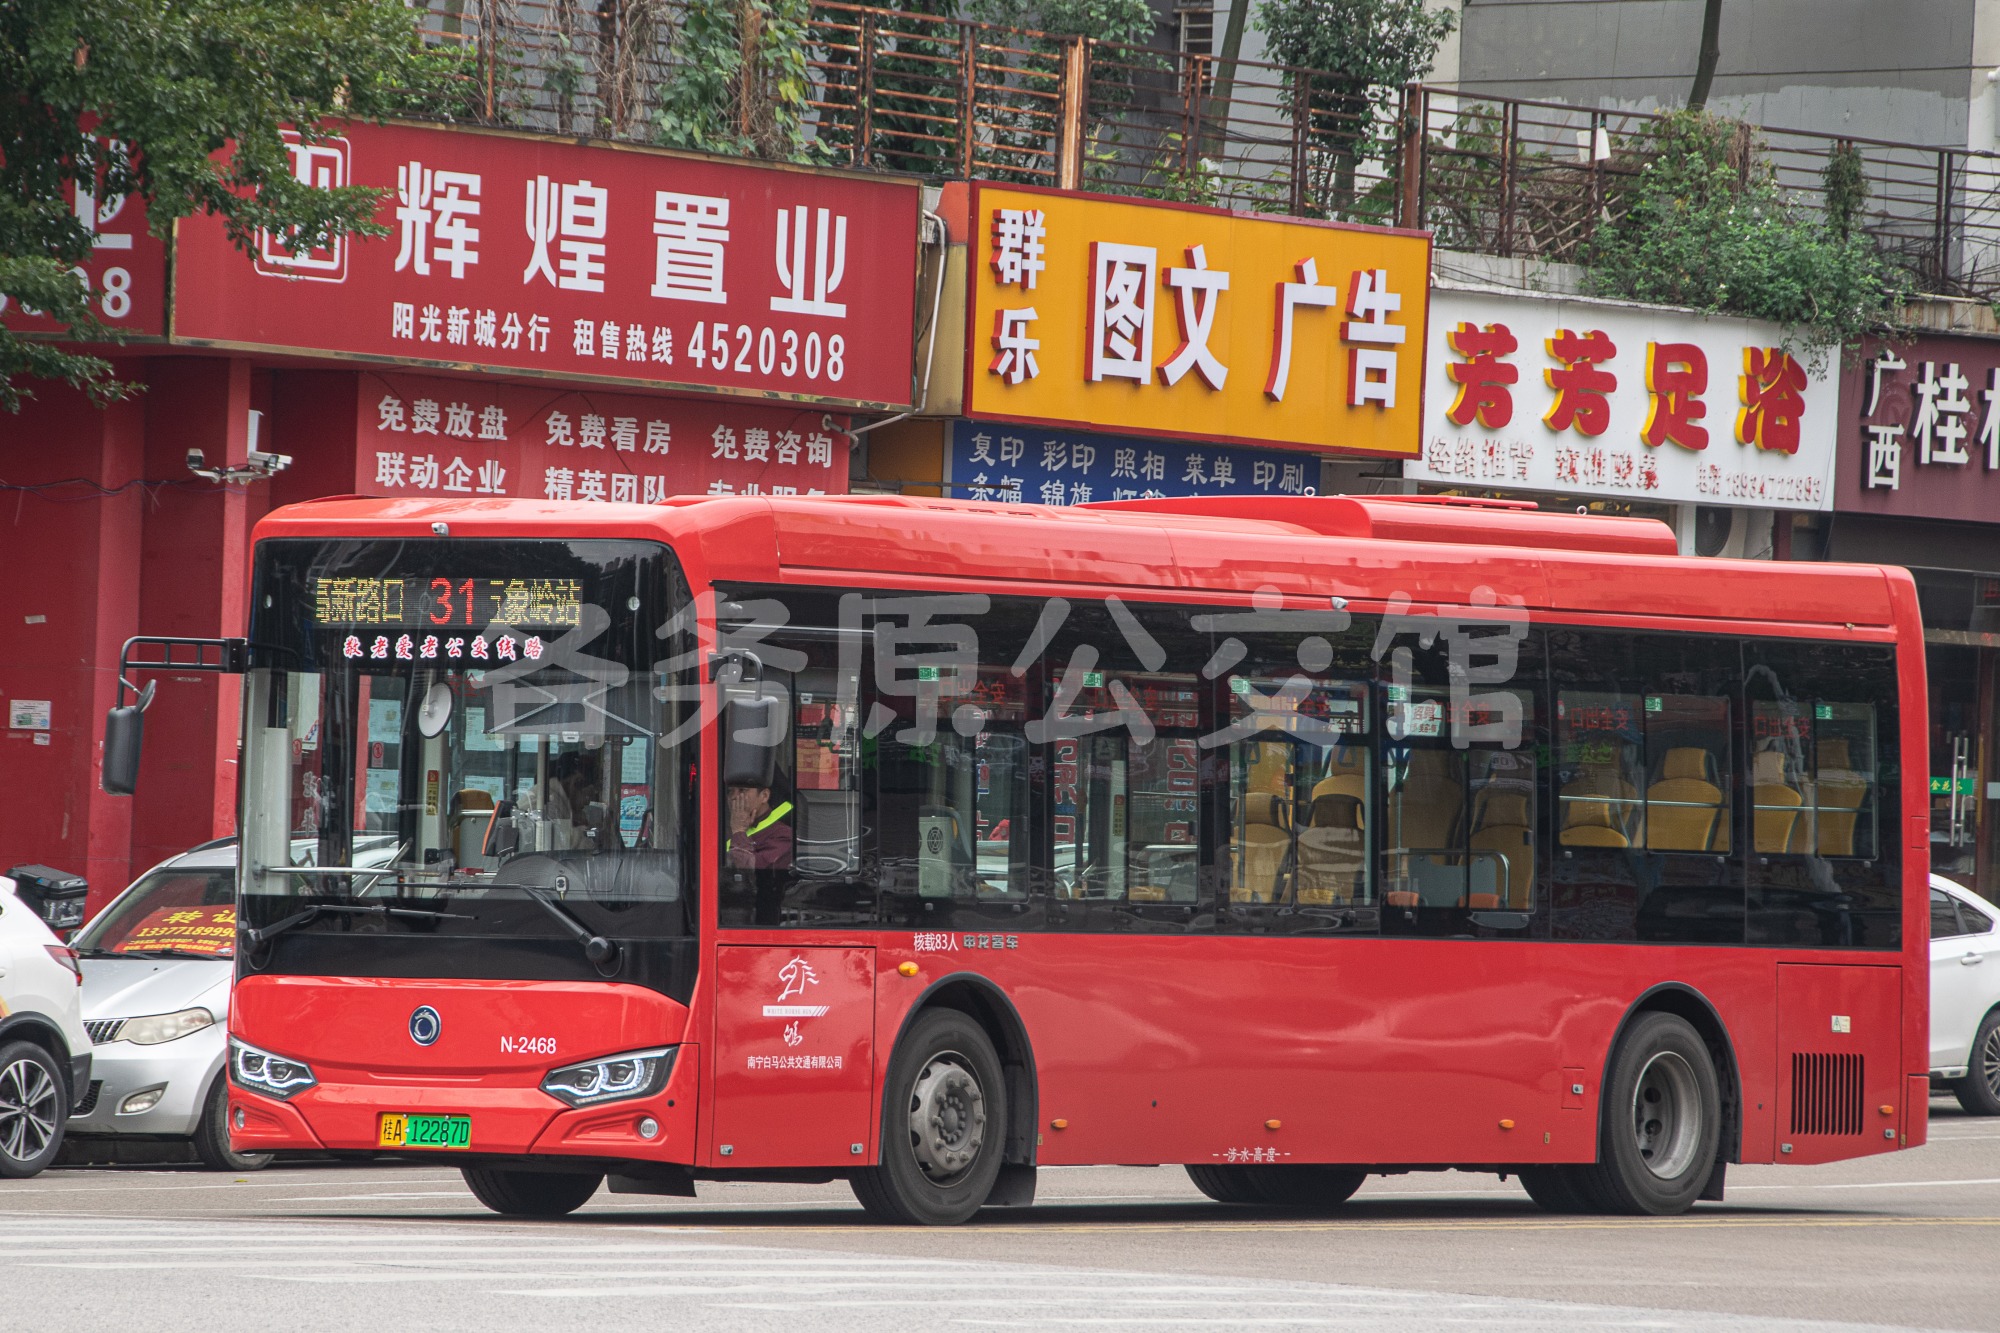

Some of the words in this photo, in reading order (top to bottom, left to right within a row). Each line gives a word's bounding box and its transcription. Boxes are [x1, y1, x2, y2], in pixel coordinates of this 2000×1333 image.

[395, 161, 847, 317] 辉煌置业
[989, 208, 1047, 385] 群乐
[392, 302, 551, 353] 阳光新城分行
[573, 318, 674, 366] 租售热线
[688, 320, 845, 382] 4520308
[1084, 241, 1406, 409] 图文广告
[1445, 321, 1808, 455] 芳芳足浴
[377, 394, 508, 442] 免费放盘
[545, 410, 672, 455] 免费看房
[1866, 348, 1908, 491] 广西
[711, 424, 833, 469] 免费咨询
[968, 432, 1025, 467] 复印
[1039, 440, 1096, 475] 彩印
[1110, 447, 1166, 481] 照相
[1181, 453, 1236, 488] 菜单
[1253, 460, 1305, 495] 印刷
[375, 450, 507, 496] 联动企业
[544, 466, 667, 505] 精英团队
[429, 577, 475, 626] 31
[343, 634, 545, 661] 敬老爱老公交线路
[913, 932, 959, 952] 核载83人
[499, 1035, 557, 1055] N-2468
[747, 1056, 842, 1069] 南宁白马公共交通有限公司
